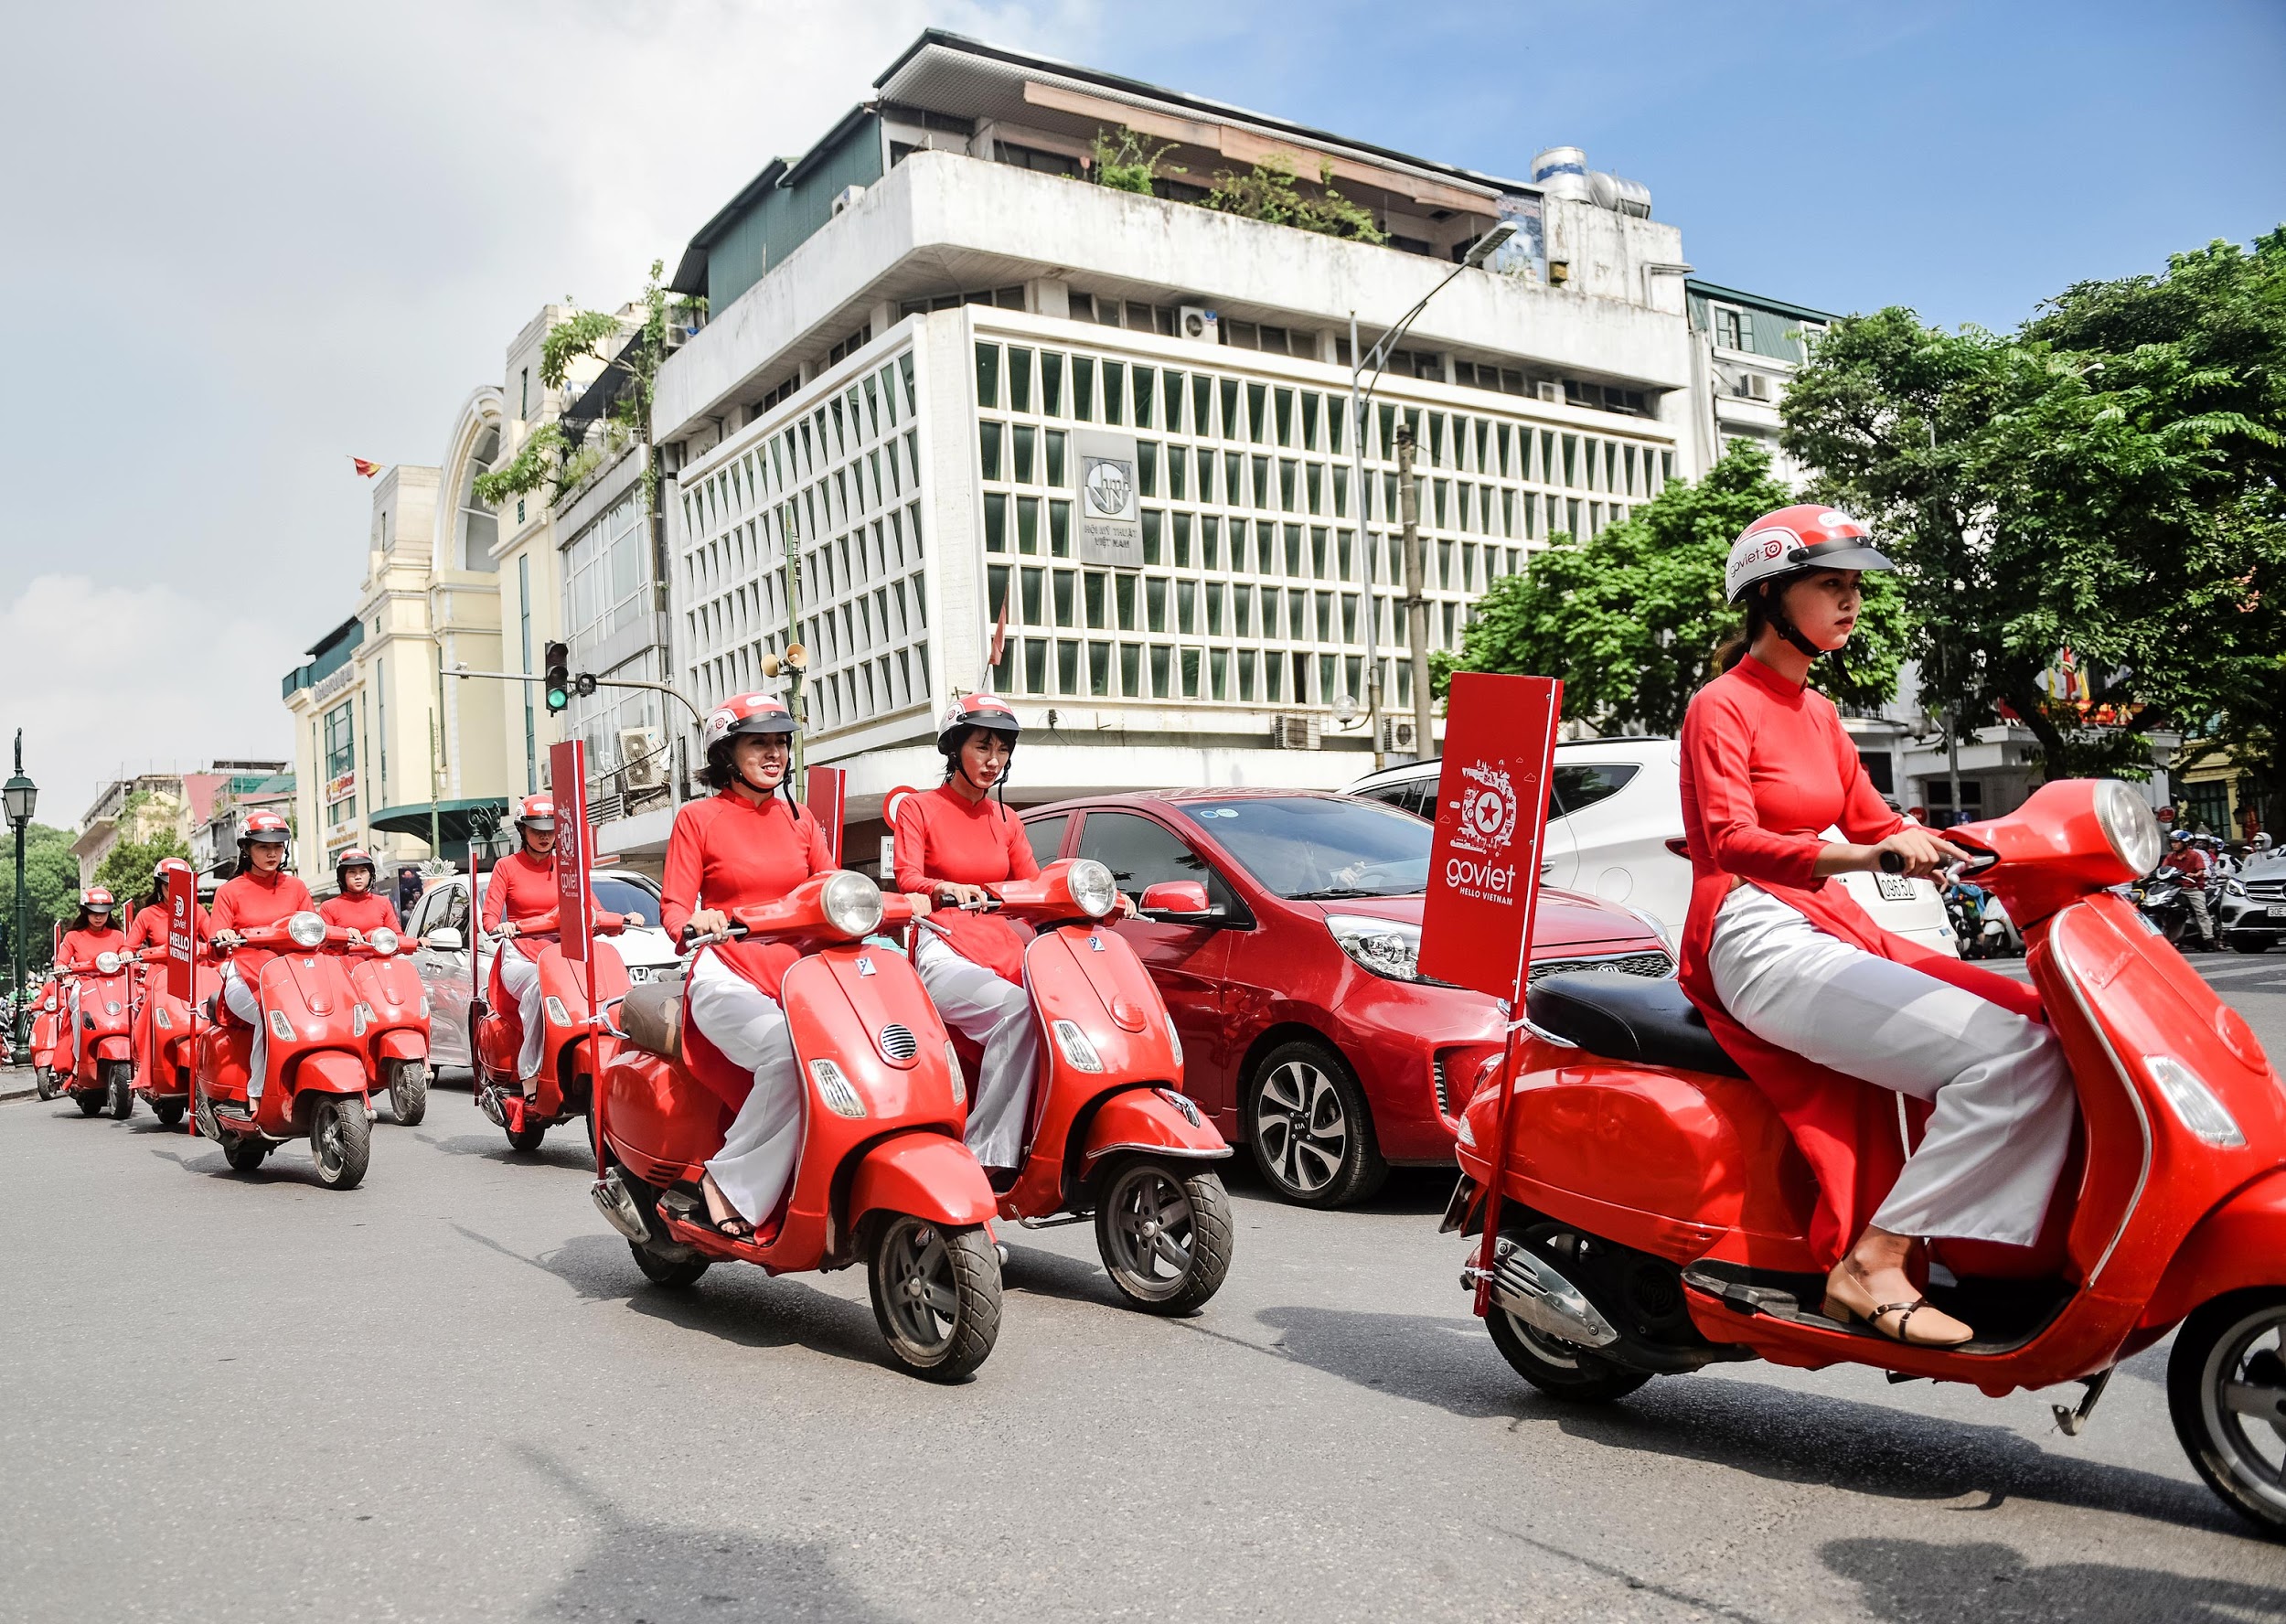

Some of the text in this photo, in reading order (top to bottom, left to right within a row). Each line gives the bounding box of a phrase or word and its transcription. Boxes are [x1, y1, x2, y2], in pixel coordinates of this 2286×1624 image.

[1112, 539, 1130, 549] NAM
[561, 869, 578, 893] goviet
[1446, 858, 1516, 893] goviet
[1459, 886, 1513, 906] HELLO VIETNAM
[1881, 879, 1914, 897] 096.52
[173, 918, 187, 930] goviet
[169, 930, 190, 952] HELLO
[168, 946, 189, 963] VIETNAM
[1294, 1122, 1306, 1130] KIA
